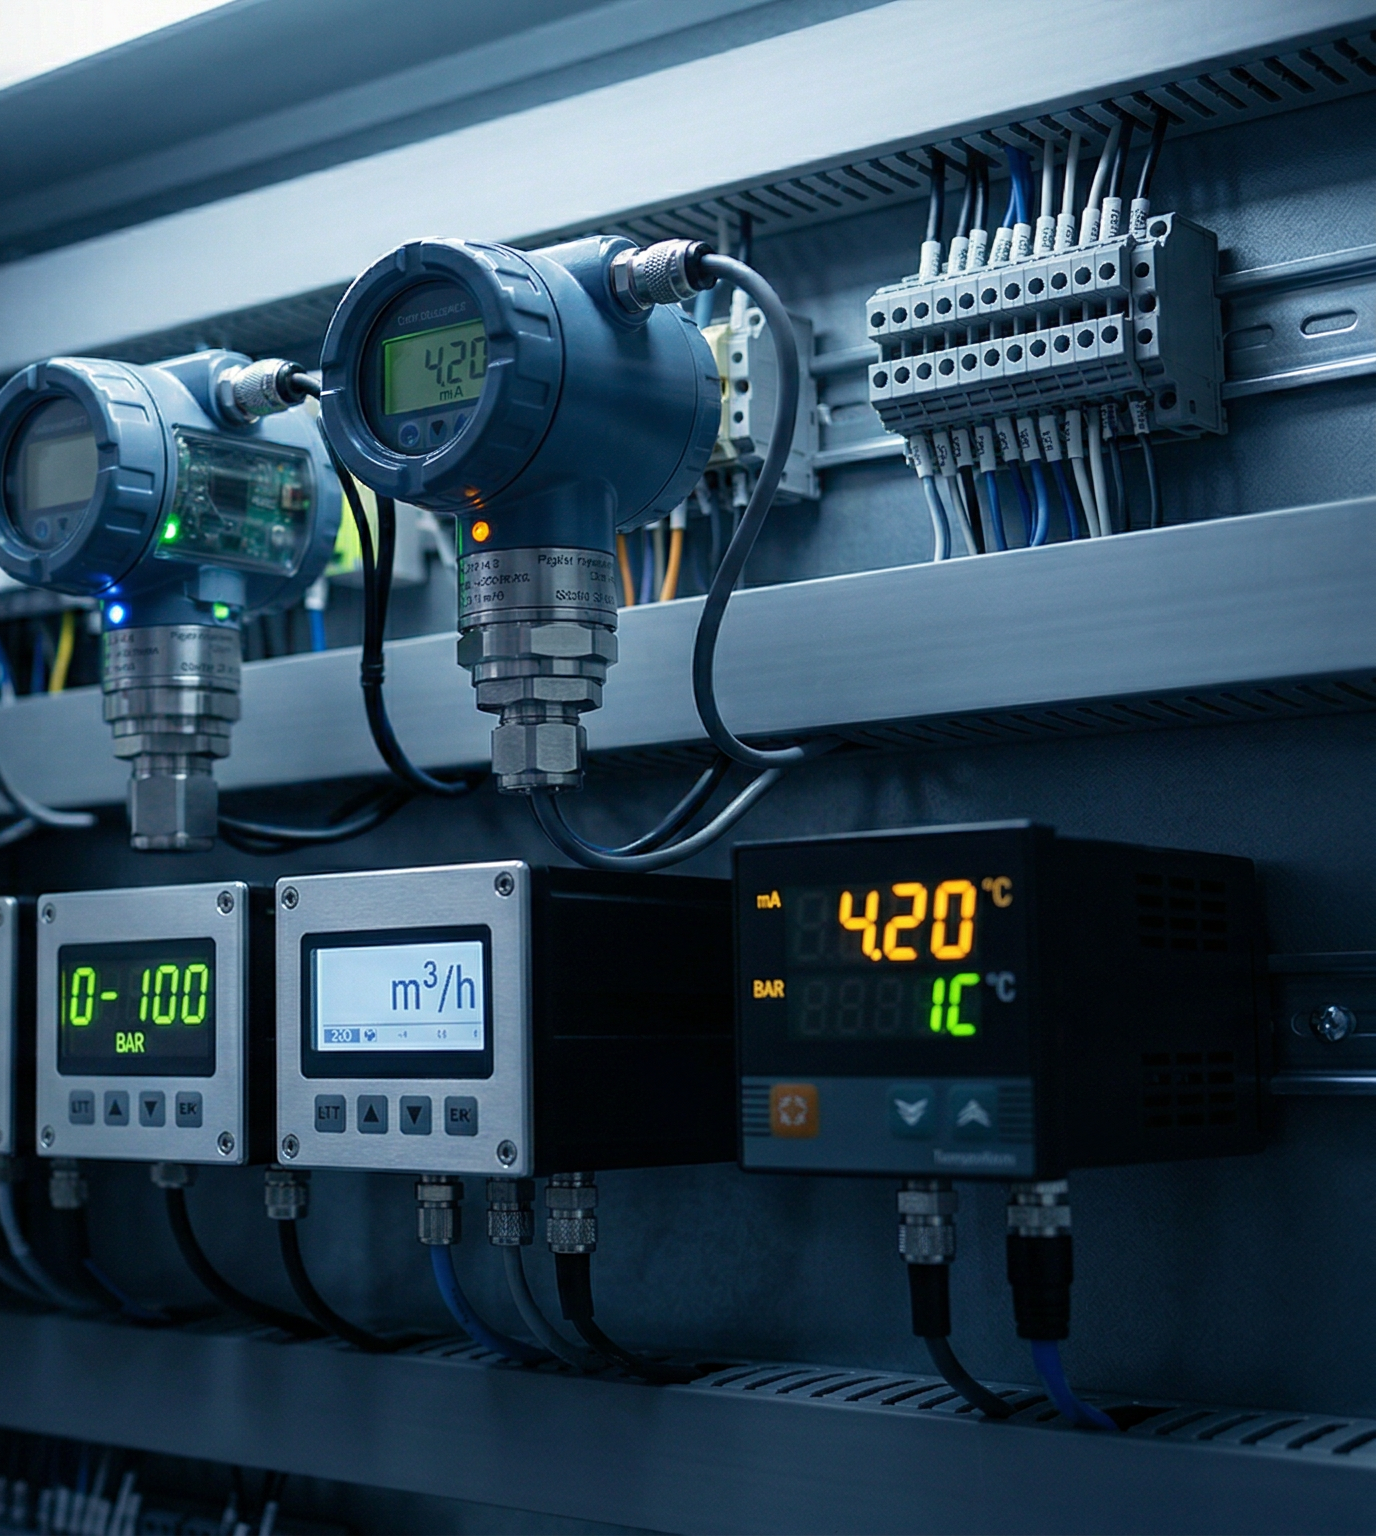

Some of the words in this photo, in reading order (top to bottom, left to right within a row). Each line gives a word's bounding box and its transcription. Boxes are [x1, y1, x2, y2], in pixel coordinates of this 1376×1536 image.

[756, 890, 782, 910] mA
[838, 879, 978, 962] 4.20
[982, 875, 1013, 908] °C
[752, 979, 785, 999] BAR
[986, 971, 1016, 1002] °C
[115, 1031, 145, 1053] BAR
